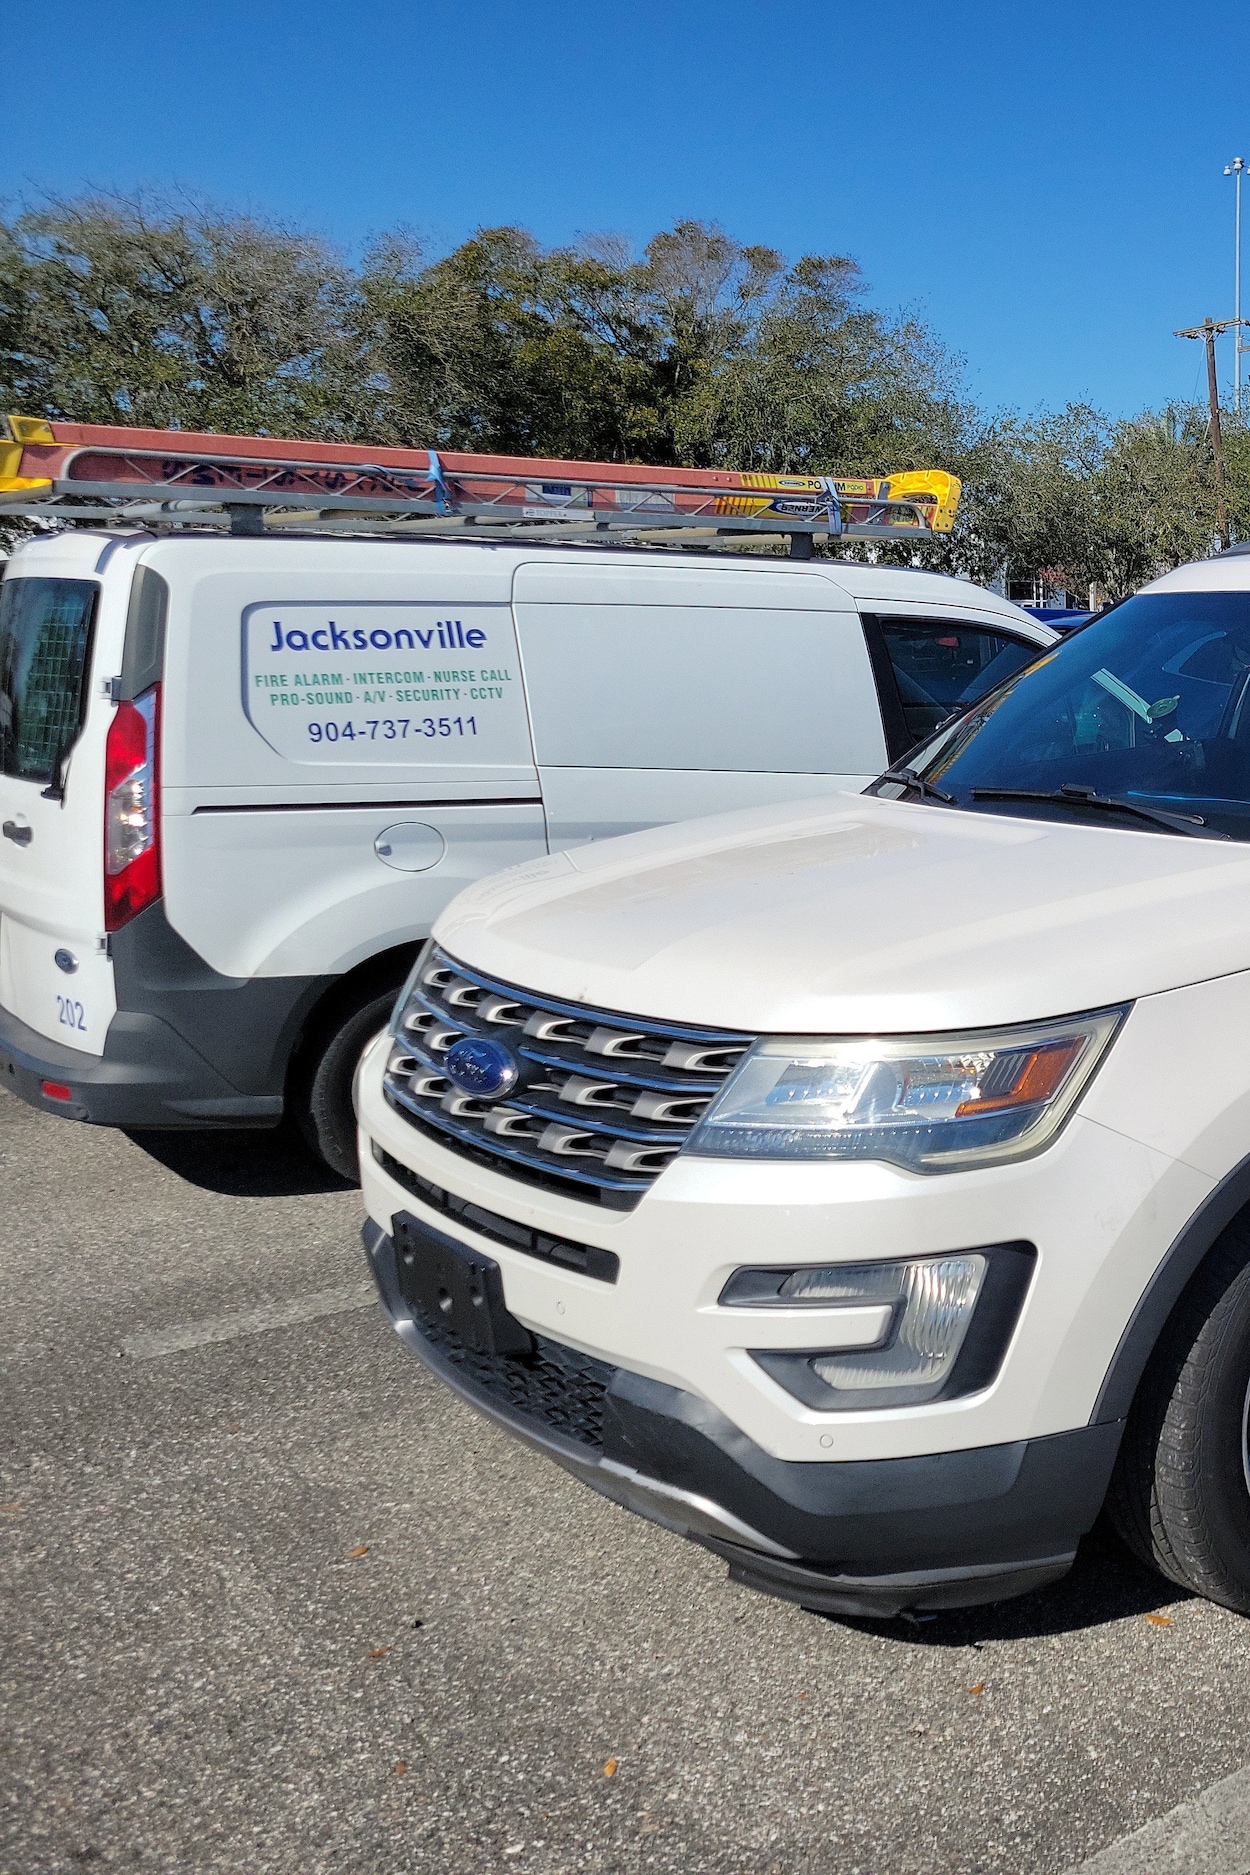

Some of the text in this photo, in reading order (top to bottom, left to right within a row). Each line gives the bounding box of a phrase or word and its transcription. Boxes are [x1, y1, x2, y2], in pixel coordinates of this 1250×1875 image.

[808, 480, 846, 491] POM
[270, 620, 487, 652] Jacksonville
[255, 669, 512, 688] FIRE ALARM INTERCOM NURSE CALL
[270, 687, 503, 706] PRO-SOUND A/V SECURITY CCTV
[308, 716, 479, 742] 904-737-3511
[56, 995, 87, 1032] 202
